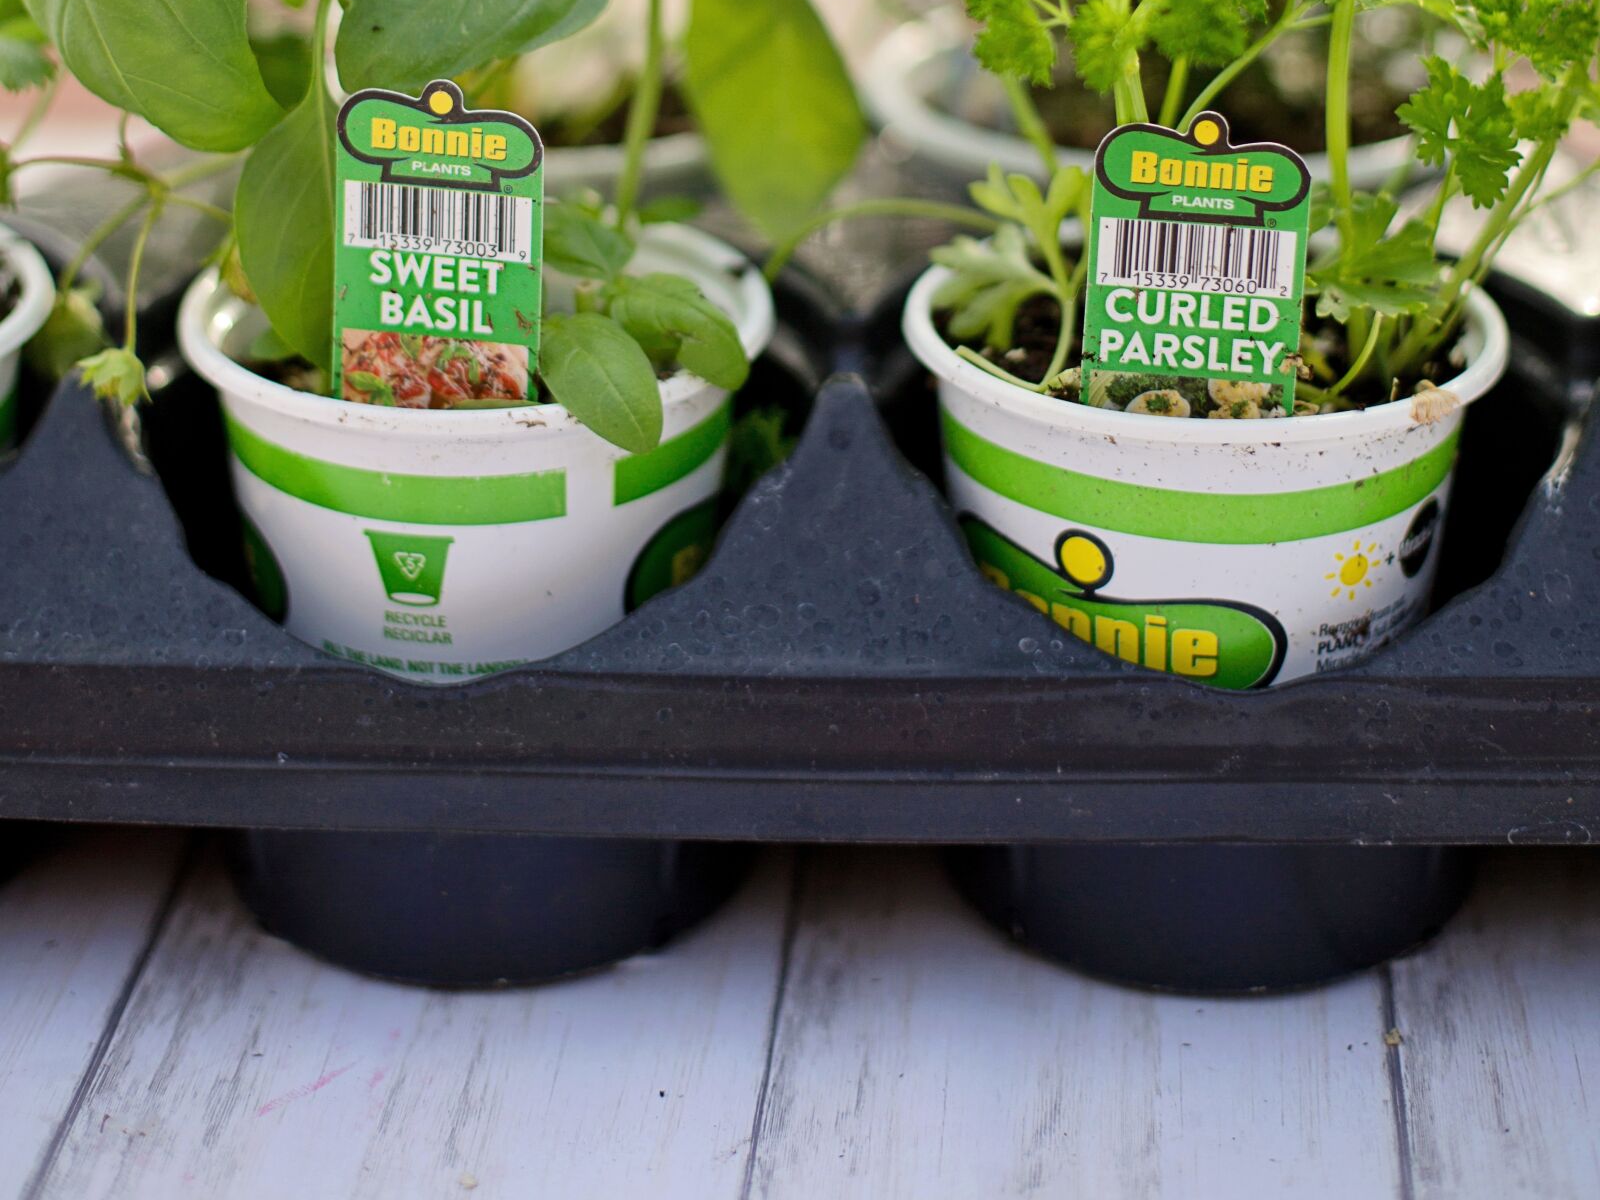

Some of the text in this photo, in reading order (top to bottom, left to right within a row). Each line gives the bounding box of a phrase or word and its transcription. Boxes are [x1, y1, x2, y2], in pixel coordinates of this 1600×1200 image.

[371, 117, 507, 161] Bonnie
[412, 161, 471, 176] PLANTS
[1130, 150, 1273, 193] Bonnie
[1172, 195, 1235, 210] PLANTS
[347, 233, 527, 262] 7 15339 73003 9
[369, 250, 501, 295] SWEET
[1100, 272, 1288, 297] 7 15339 73060 2
[380, 291, 493, 334] BASIL
[1105, 287, 1280, 333] CURLED
[1100, 329, 1285, 375] PARSLEY
[384, 609, 447, 628] RECYCLE
[383, 626, 453, 645] RECICLAR
[407, 658, 434, 673] NOT
[438, 661, 463, 675] THE
